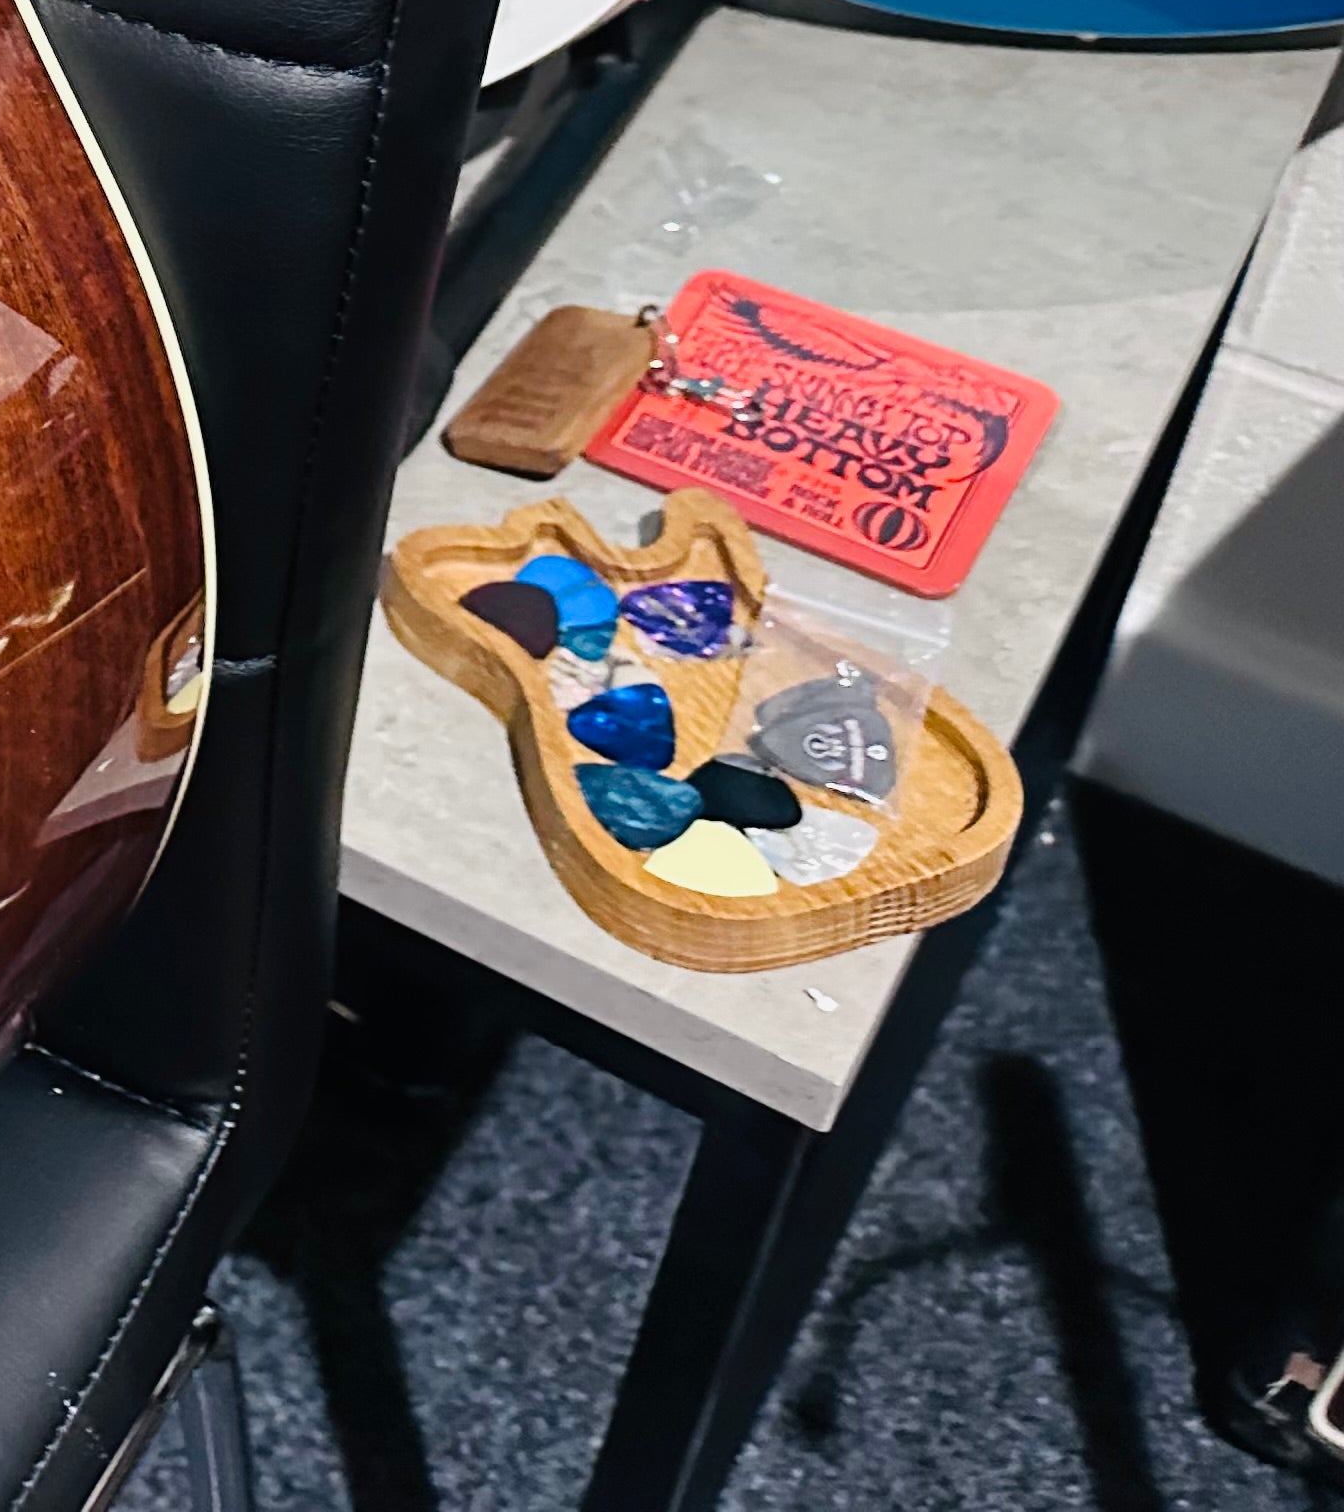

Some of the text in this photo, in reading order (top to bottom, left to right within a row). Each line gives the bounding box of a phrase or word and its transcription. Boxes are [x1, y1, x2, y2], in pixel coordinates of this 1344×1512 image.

[720, 416, 944, 513] BOTTOM
[751, 376, 951, 479] HEAVY
[898, 408, 972, 454] TOP
